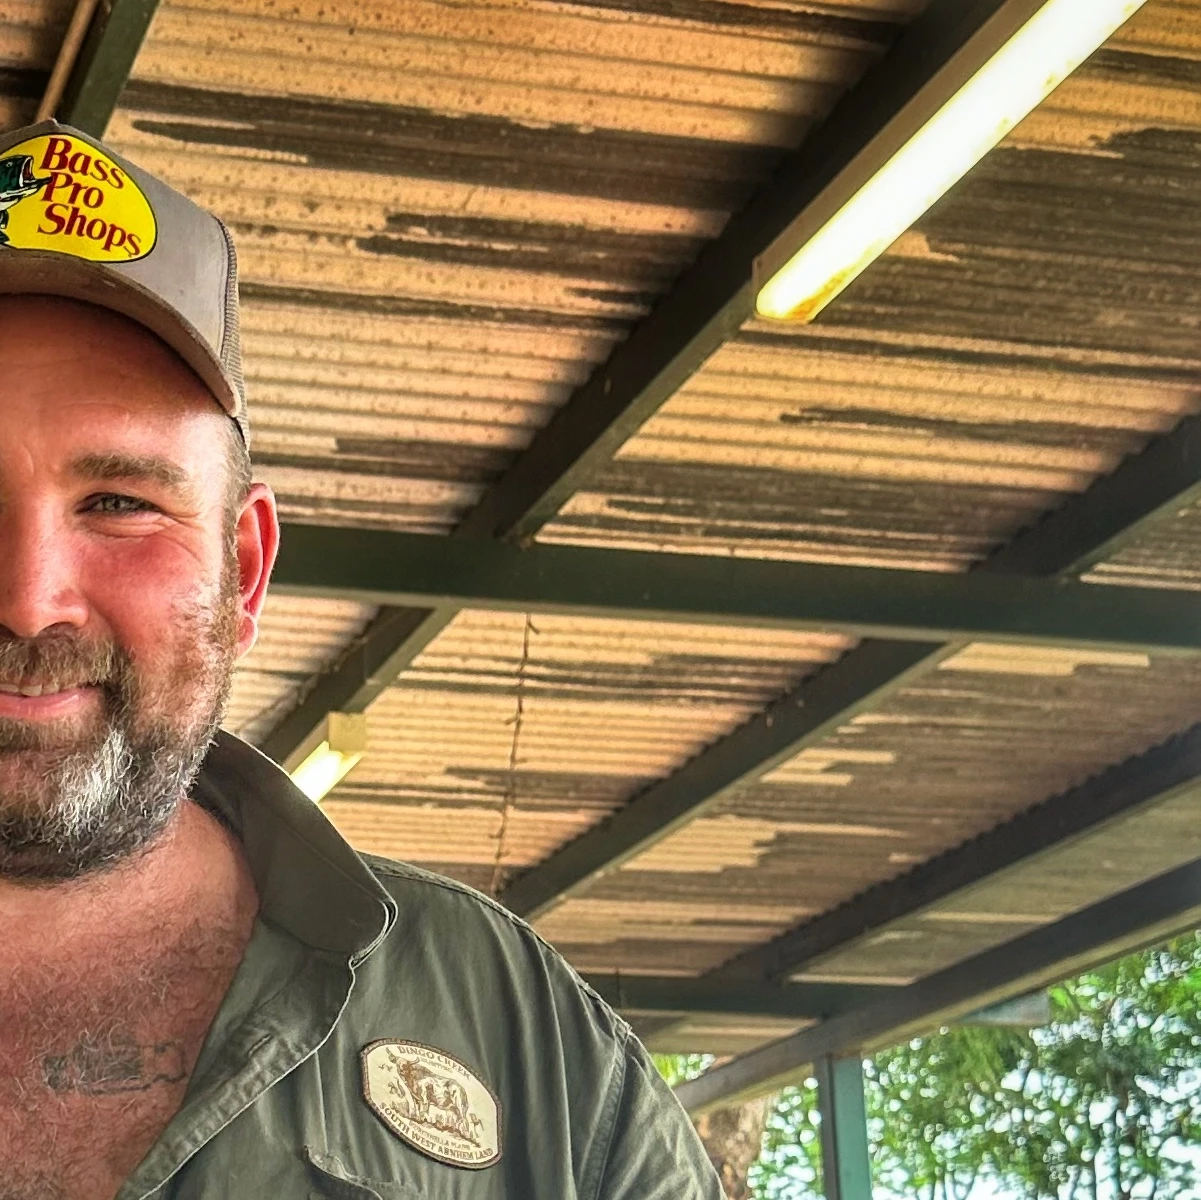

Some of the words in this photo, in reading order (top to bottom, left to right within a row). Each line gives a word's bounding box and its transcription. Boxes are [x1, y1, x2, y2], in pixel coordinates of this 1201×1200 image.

[39, 137, 124, 189] Bass
[41, 171, 104, 209] Pro
[37, 203, 141, 257] Shops
[397, 1045, 435, 1060] DINGO
[379, 1102, 409, 1136] SOUTH
[411, 1130, 436, 1150] WEST
[474, 1147, 494, 1160] LAND
